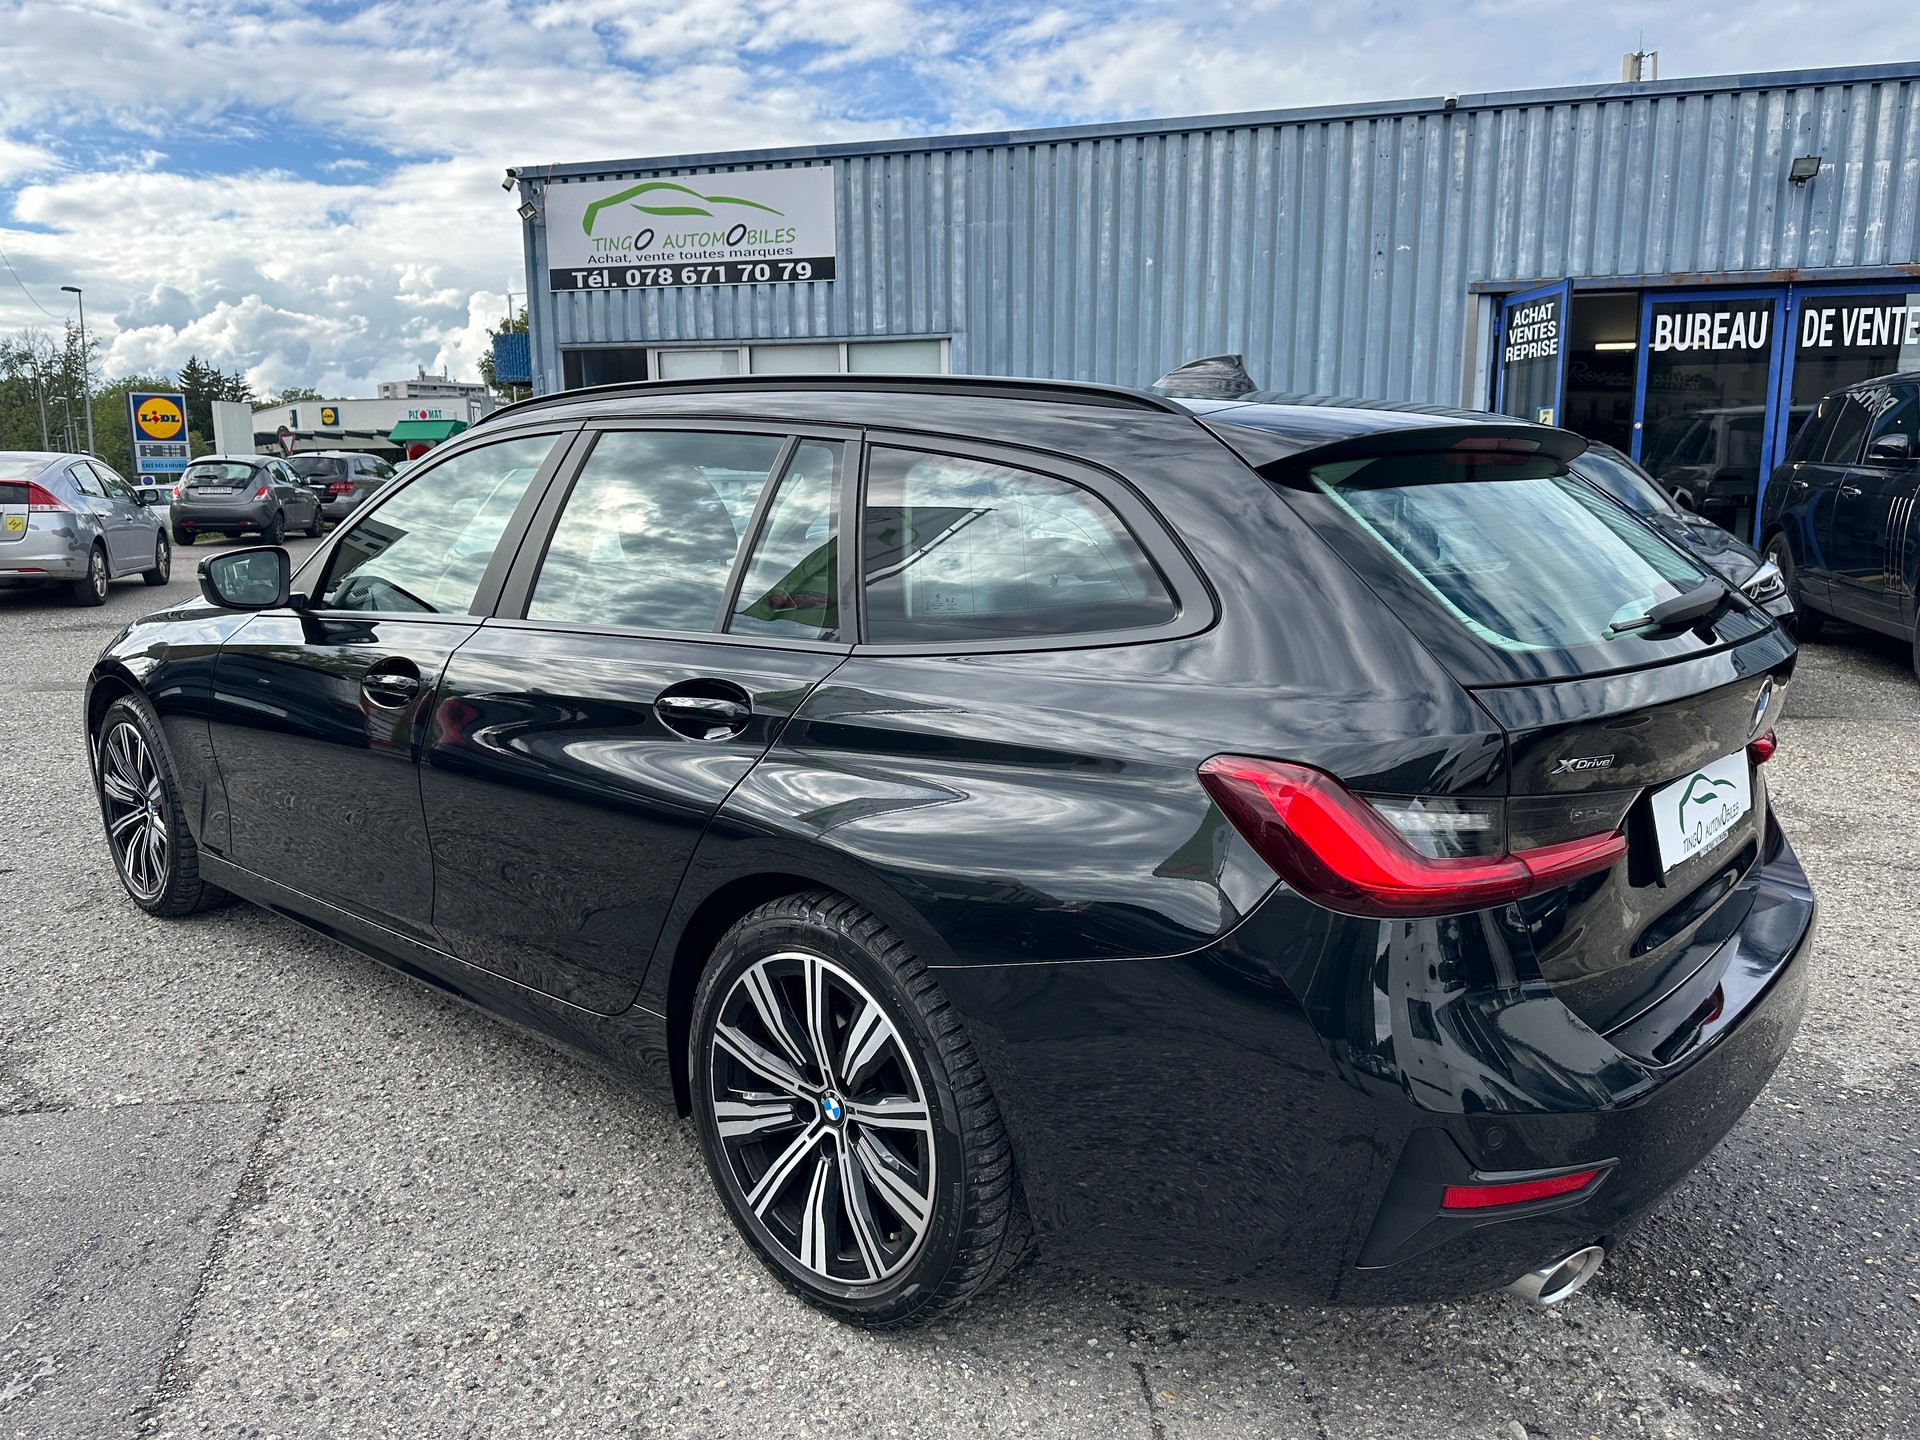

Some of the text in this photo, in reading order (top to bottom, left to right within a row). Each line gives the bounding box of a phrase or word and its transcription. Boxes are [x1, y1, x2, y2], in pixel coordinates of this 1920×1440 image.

[592, 223, 796, 252] TINGO AUTOMOBILES
[587, 246, 793, 265] Achat, vente toutes marques
[572, 261, 812, 288] Tél. 078 671 70 79
[1512, 302, 1556, 327] ACHAT
[1508, 320, 1557, 345] VENTES
[1653, 306, 1920, 352] BUREAU DE VENTE
[1504, 337, 1558, 363] REPRISE
[1682, 821, 1702, 853] TINGO
[1705, 803, 1740, 839] AUTOMOBILES
